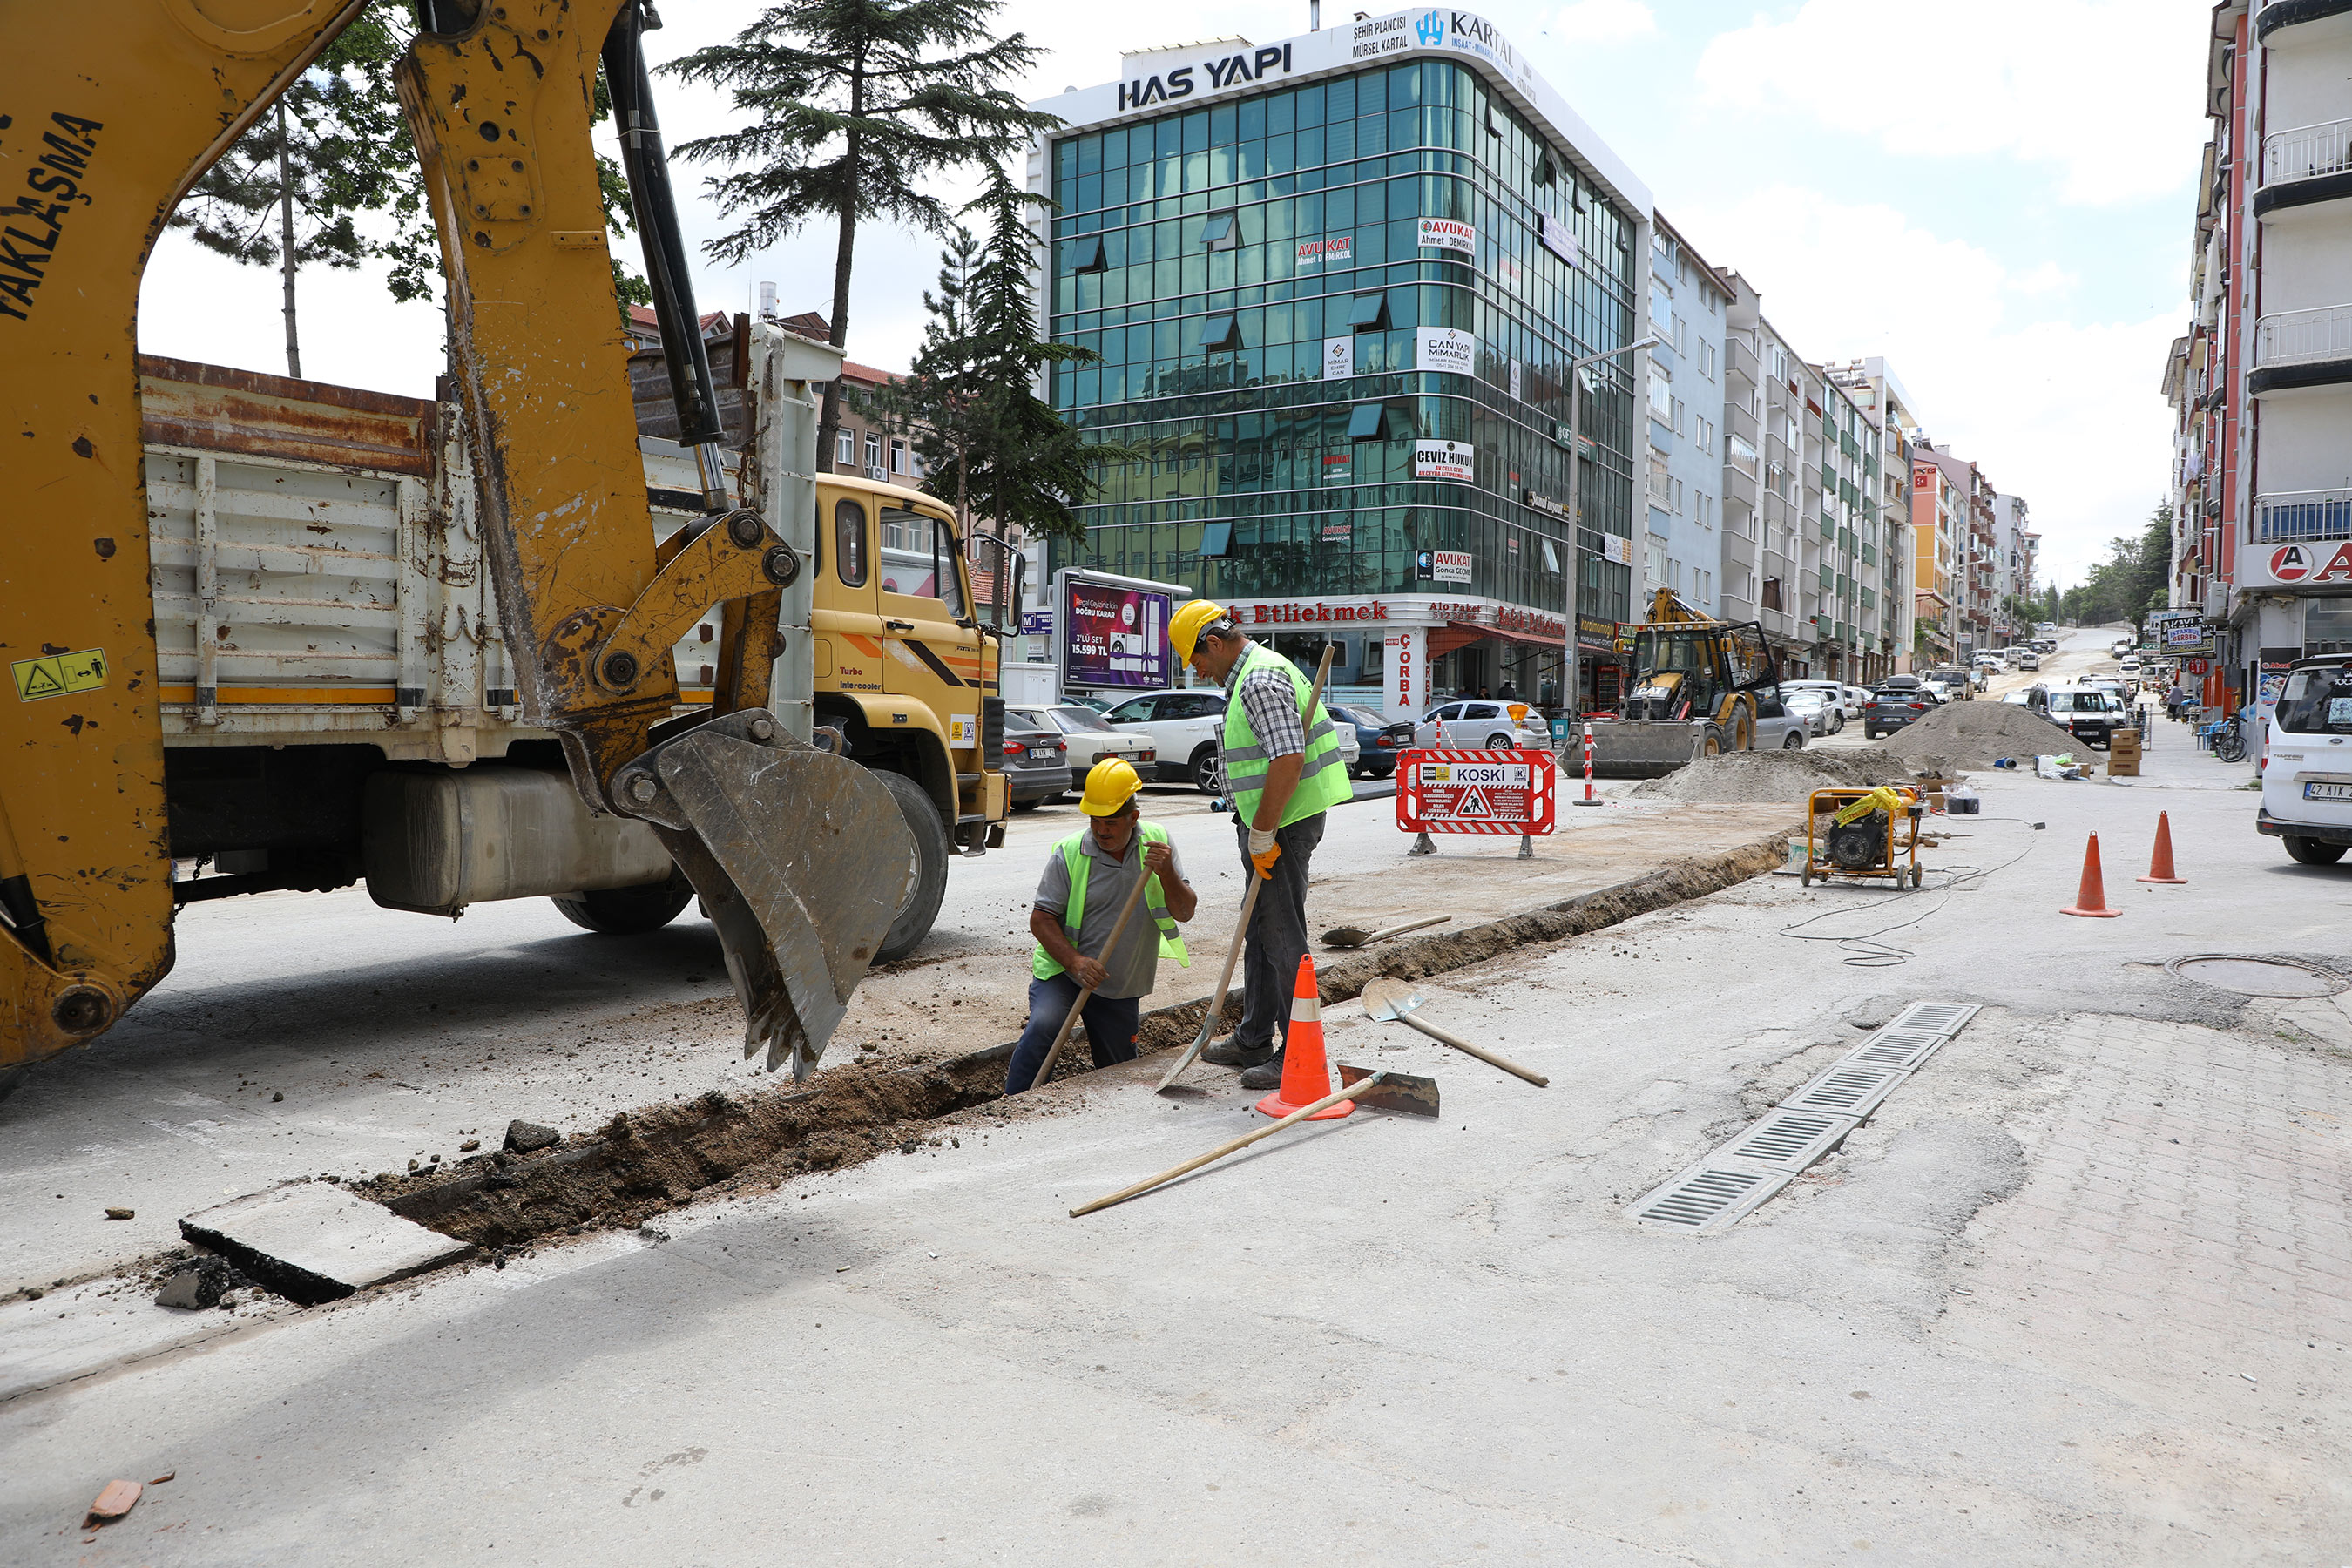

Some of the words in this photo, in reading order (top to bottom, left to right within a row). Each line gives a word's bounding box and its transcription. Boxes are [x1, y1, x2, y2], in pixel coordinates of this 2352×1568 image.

[1354, 22, 1374, 43] ŞEHİR
[1375, 15, 1407, 34] PLANCISI
[1352, 39, 1380, 58] MÜRSEL
[1381, 35, 1408, 51] KARTAL
[1450, 11, 1514, 69] KARTAL
[1119, 67, 1194, 112] HAS
[1204, 43, 1291, 88] YAPI
[1432, 221, 1474, 240] AVUKAT
[1421, 234, 1444, 245] Ahmet
[1449, 236, 1475, 253] DEMİRKOL
[1429, 339, 1454, 349] CAN
[1456, 341, 1470, 354] YAPI
[1429, 348, 1470, 362] MİMARLIK
[1416, 449, 1448, 463] CEVİZ
[1448, 452, 1473, 468] HUKUK
[1435, 552, 1471, 568] AVUKAT
[1075, 607, 1096, 617] DOĞRU
[1096, 609, 1116, 618] KARAR
[1254, 600, 1388, 624] Etliekmek
[1429, 601, 1450, 612] Alo
[1453, 603, 1482, 613] Paket
[1071, 644, 1097, 656] 15.599
[1098, 646, 1108, 656] TL
[839, 666, 863, 676] Turbo
[1398, 633, 1411, 706] ÇORBA
[839, 680, 882, 691] Intercooler
[1638, 686, 1665, 695] CAT
[1457, 767, 1505, 781] KOSKİ
[2310, 785, 2322, 796] 42
